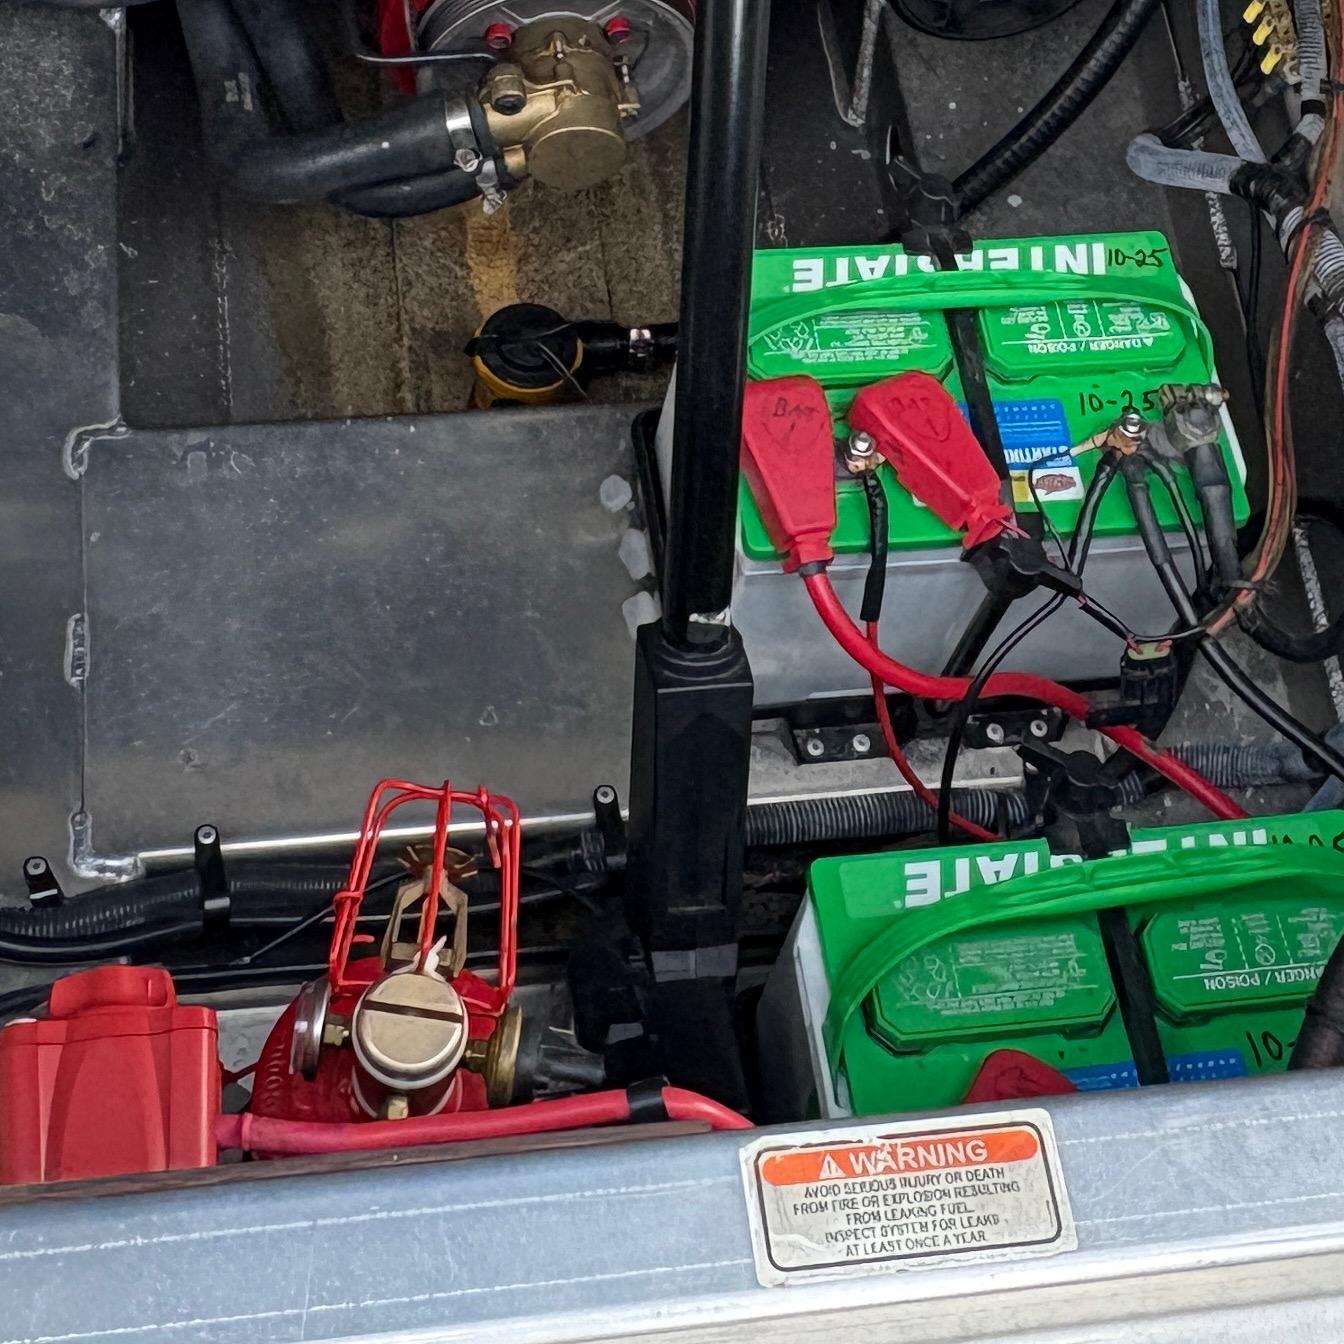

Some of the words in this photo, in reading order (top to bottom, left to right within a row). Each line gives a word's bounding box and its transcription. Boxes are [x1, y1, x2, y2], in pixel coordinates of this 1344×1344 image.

[1108, 246, 1168, 268] 10-25
[1078, 389, 1159, 416] 10-25
[849, 1139, 988, 1175] WARNING
[945, 1172, 963, 1184] OR
[965, 1167, 1005, 1182] DEATH
[793, 1201, 828, 1215] FROM
[862, 1195, 880, 1208] OR
[954, 1181, 1021, 1198] RESULTING
[846, 1211, 882, 1225] FROM
[932, 1218, 957, 1232] FOR
[846, 1244, 861, 1257] AT
[863, 1239, 902, 1255] LEAST
[905, 1236, 940, 1250] ONCE
[943, 1234, 952, 1246] A
